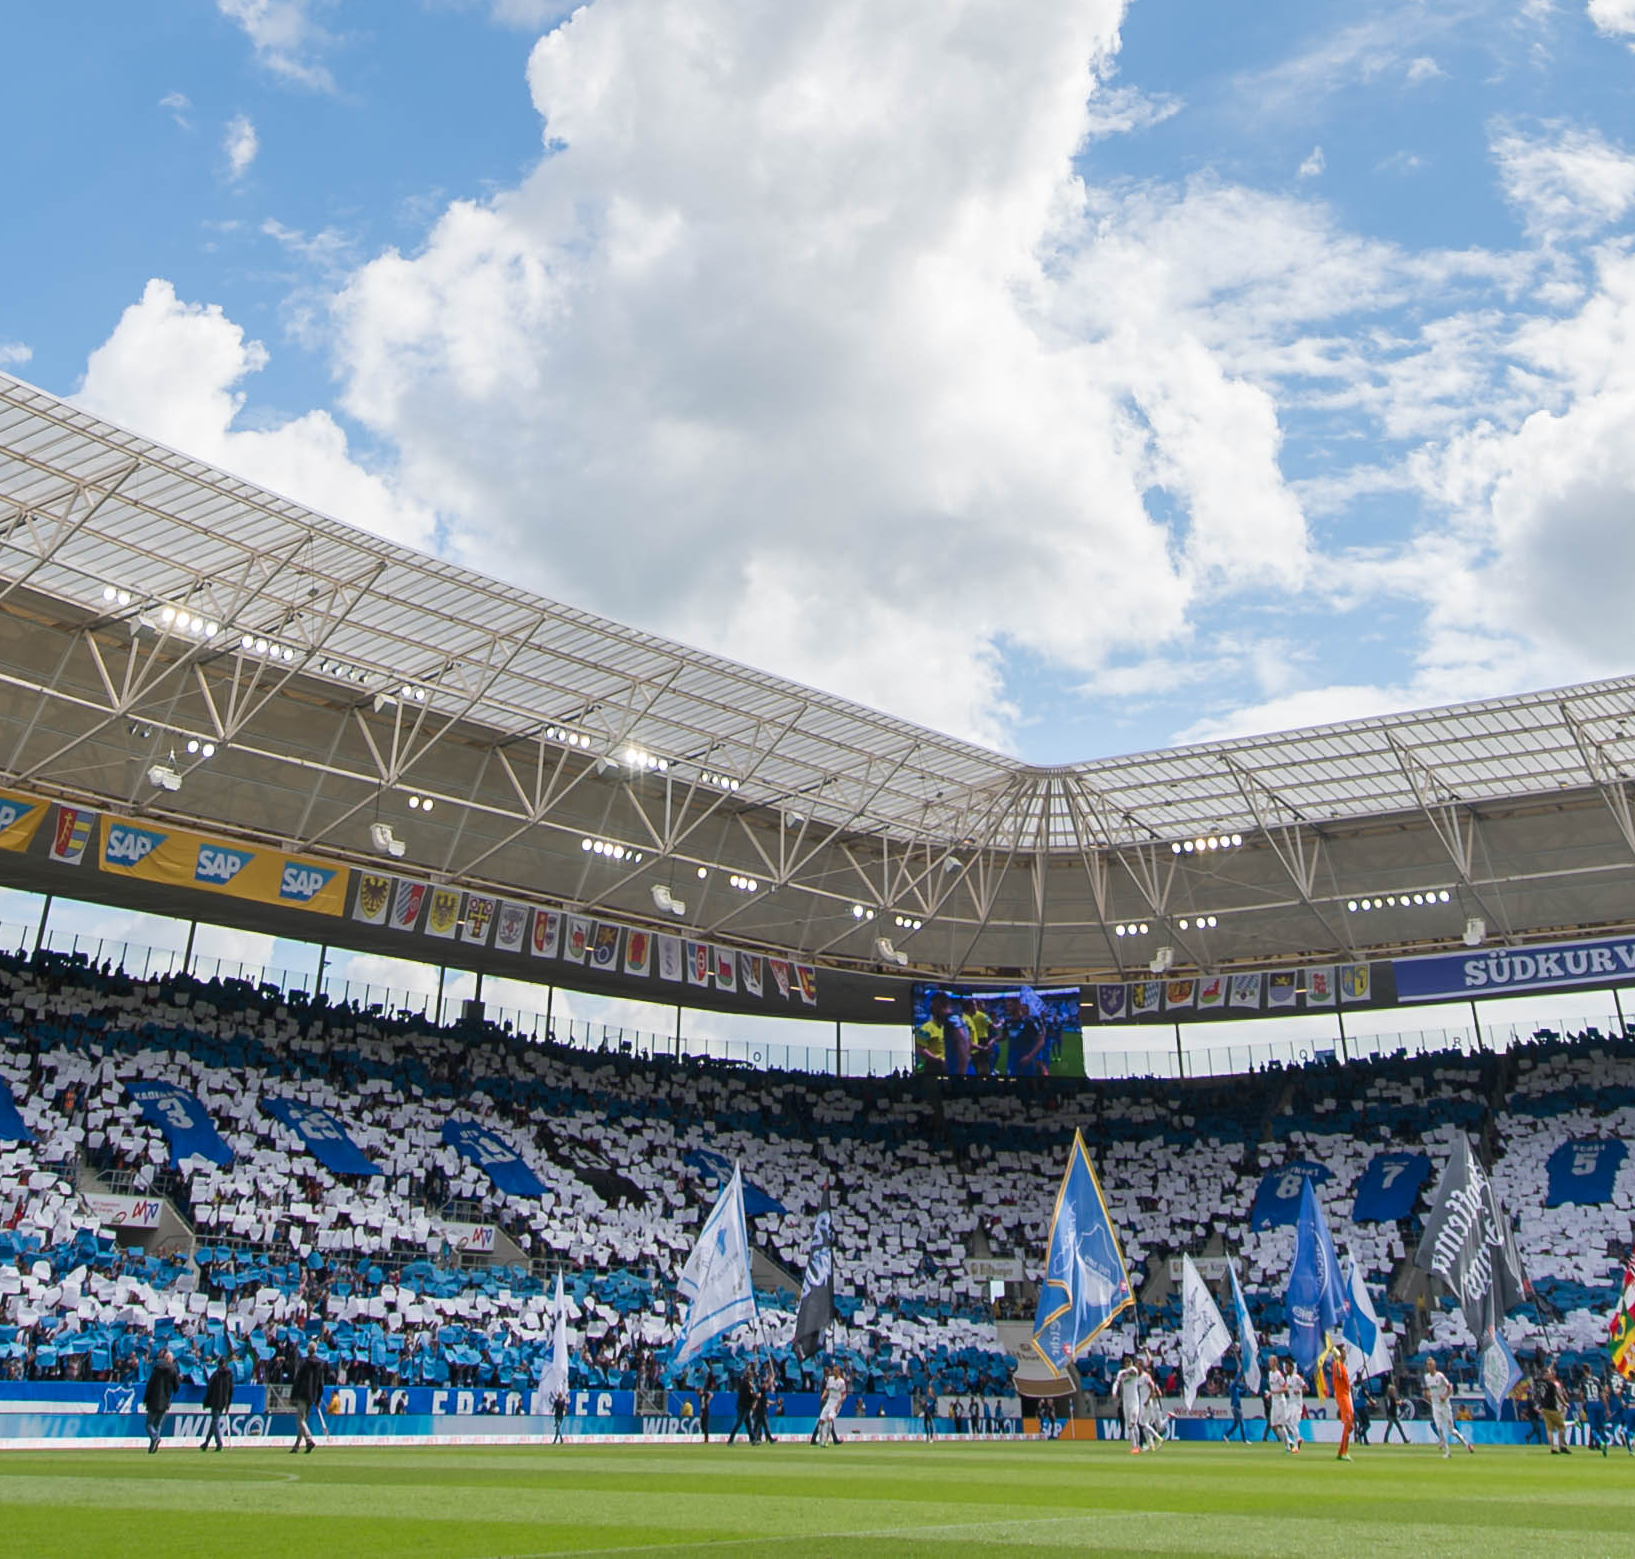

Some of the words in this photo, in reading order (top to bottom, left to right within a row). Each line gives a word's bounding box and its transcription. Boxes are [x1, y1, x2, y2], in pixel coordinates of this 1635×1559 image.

[107, 830, 151, 860] SAP
[197, 850, 241, 879] SAP
[282, 868, 323, 896] SAP
[158, 1097, 194, 1129] 3
[1572, 1152, 1599, 1176] 5
[1275, 1175, 1303, 1199] 8
[1382, 1165, 1406, 1190] 7
[643, 1417, 705, 1435] WIRSO
